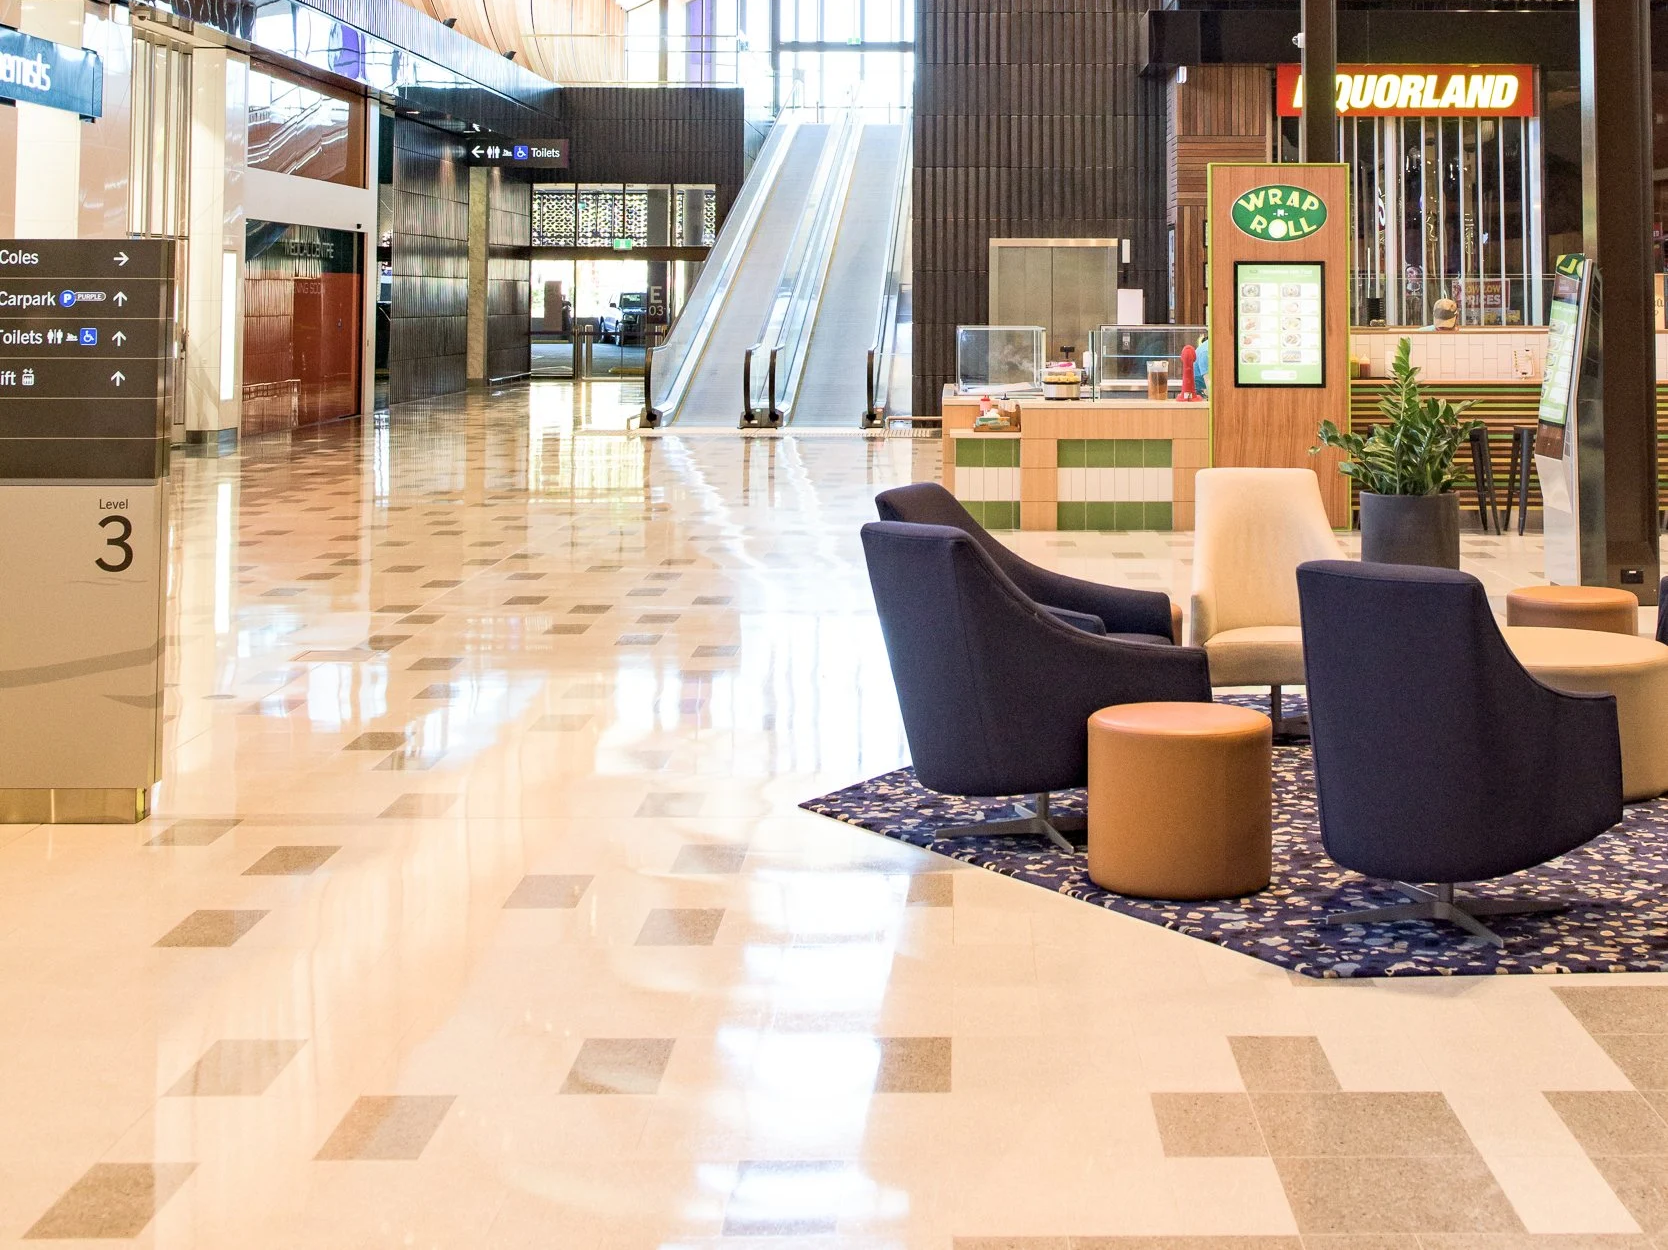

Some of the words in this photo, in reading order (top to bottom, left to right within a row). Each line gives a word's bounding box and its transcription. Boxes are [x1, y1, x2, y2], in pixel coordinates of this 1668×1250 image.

[0, 51, 51, 92] emists
[1292, 73, 1519, 113] QUORLAND
[530, 147, 561, 158] Toilets
[1237, 188, 1320, 212] WRAP
[1249, 214, 1318, 239] ROLL
[0, 249, 39, 265] Coles
[0, 291, 56, 309] Carpark
[77, 293, 102, 301] PURPLE
[650, 285, 663, 304] E
[648, 305, 664, 316] 03
[0, 370, 16, 386] ift
[99, 498, 129, 510] Level
[95, 515, 134, 573] 3
